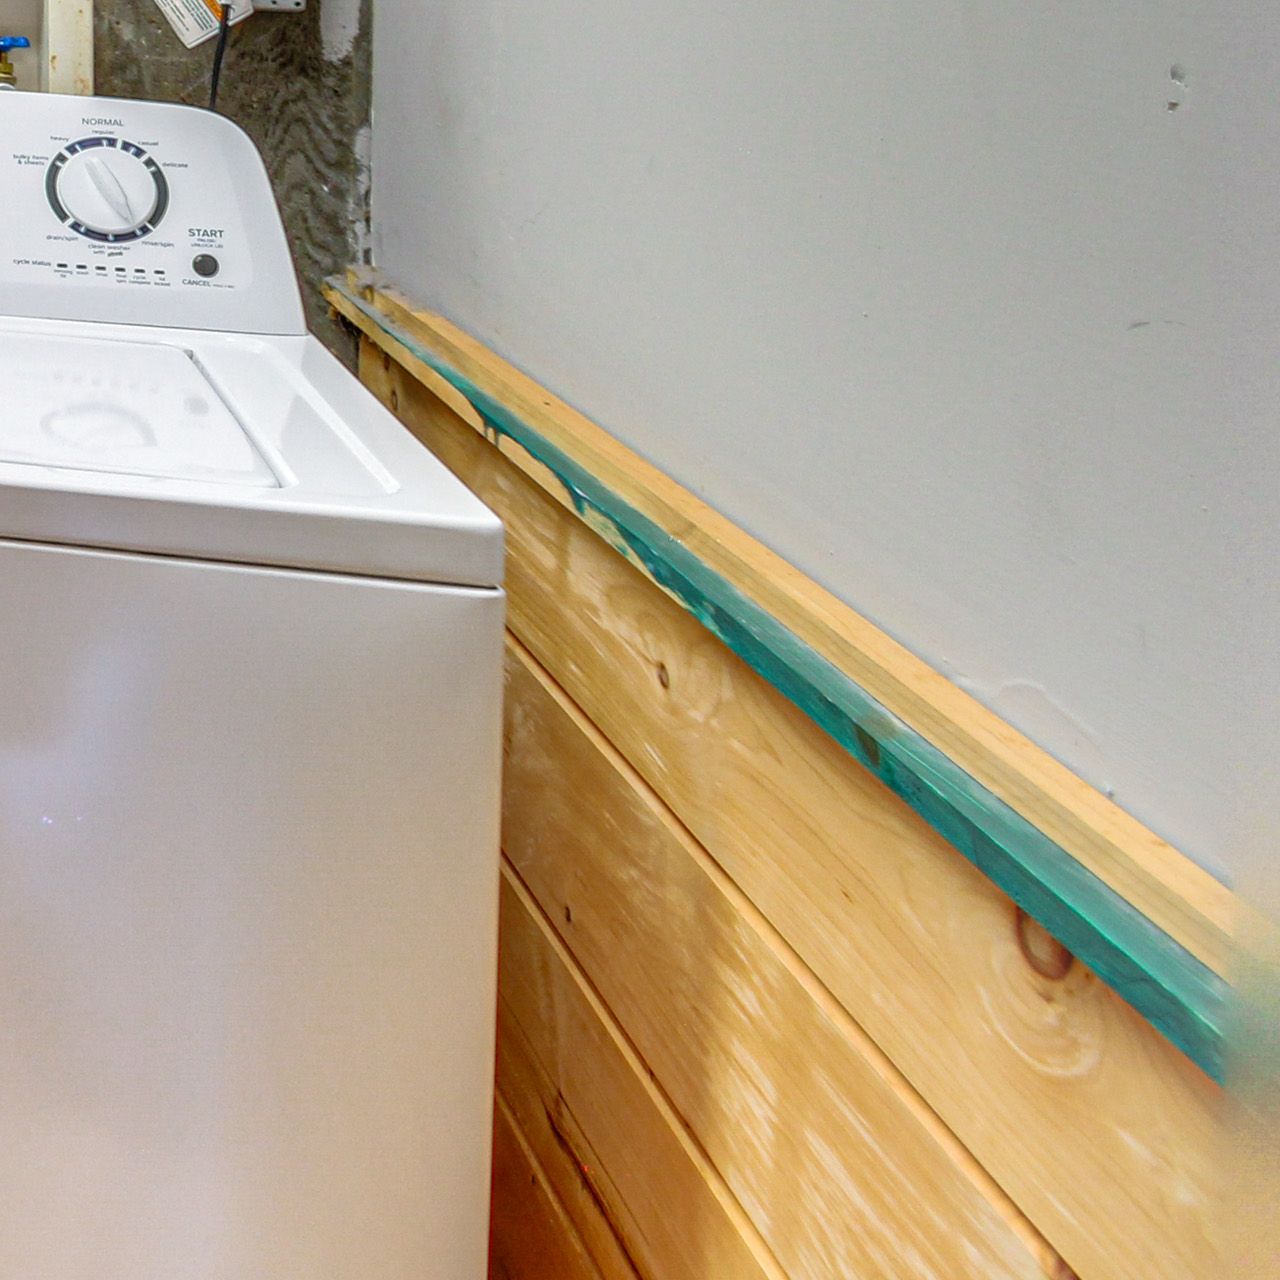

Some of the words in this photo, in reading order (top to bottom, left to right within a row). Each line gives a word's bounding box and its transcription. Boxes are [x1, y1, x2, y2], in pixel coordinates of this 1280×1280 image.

[81, 117, 124, 127] NORMAL
[187, 228, 224, 239] START
[182, 278, 211, 287] CANCEL
